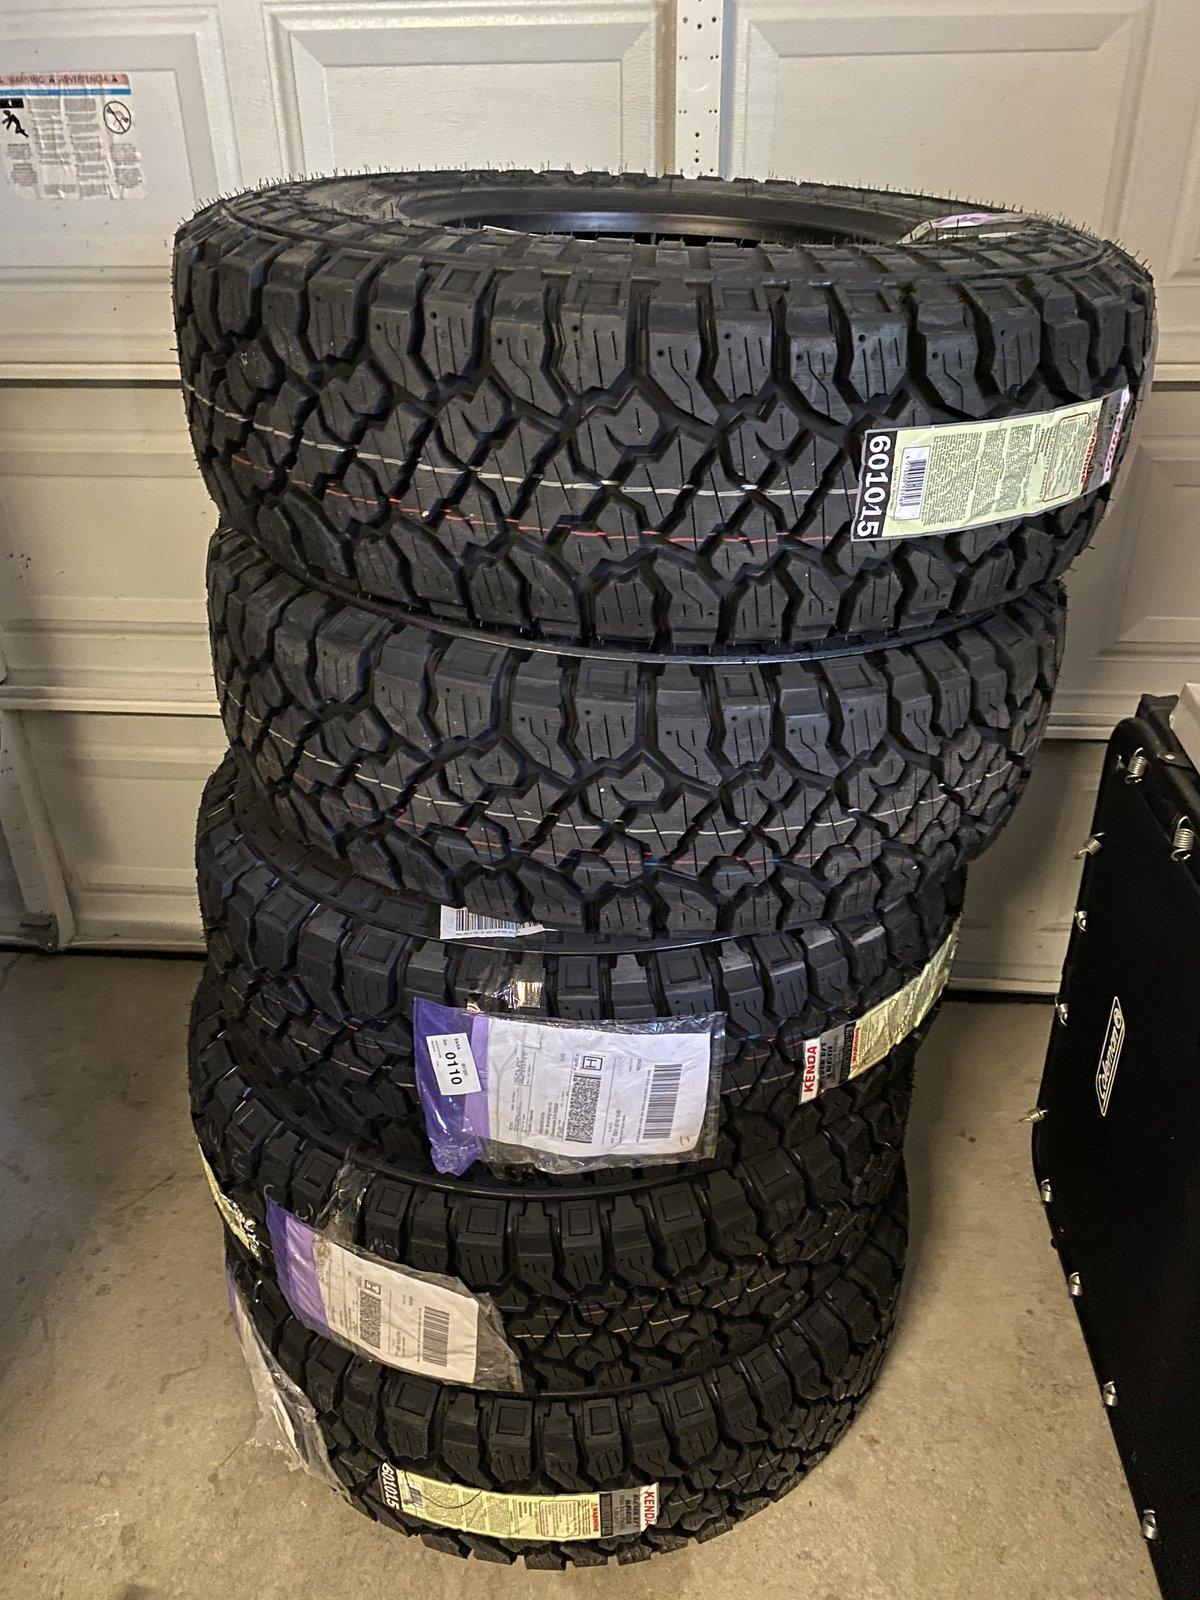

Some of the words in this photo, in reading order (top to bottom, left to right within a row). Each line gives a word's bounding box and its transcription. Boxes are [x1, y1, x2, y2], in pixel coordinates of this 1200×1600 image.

[857, 435, 891, 536] 601015
[445, 1052, 463, 1085] 0110
[585, 1059, 597, 1068] H
[803, 1045, 818, 1092] KENDA
[381, 1462, 400, 1510] 601015
